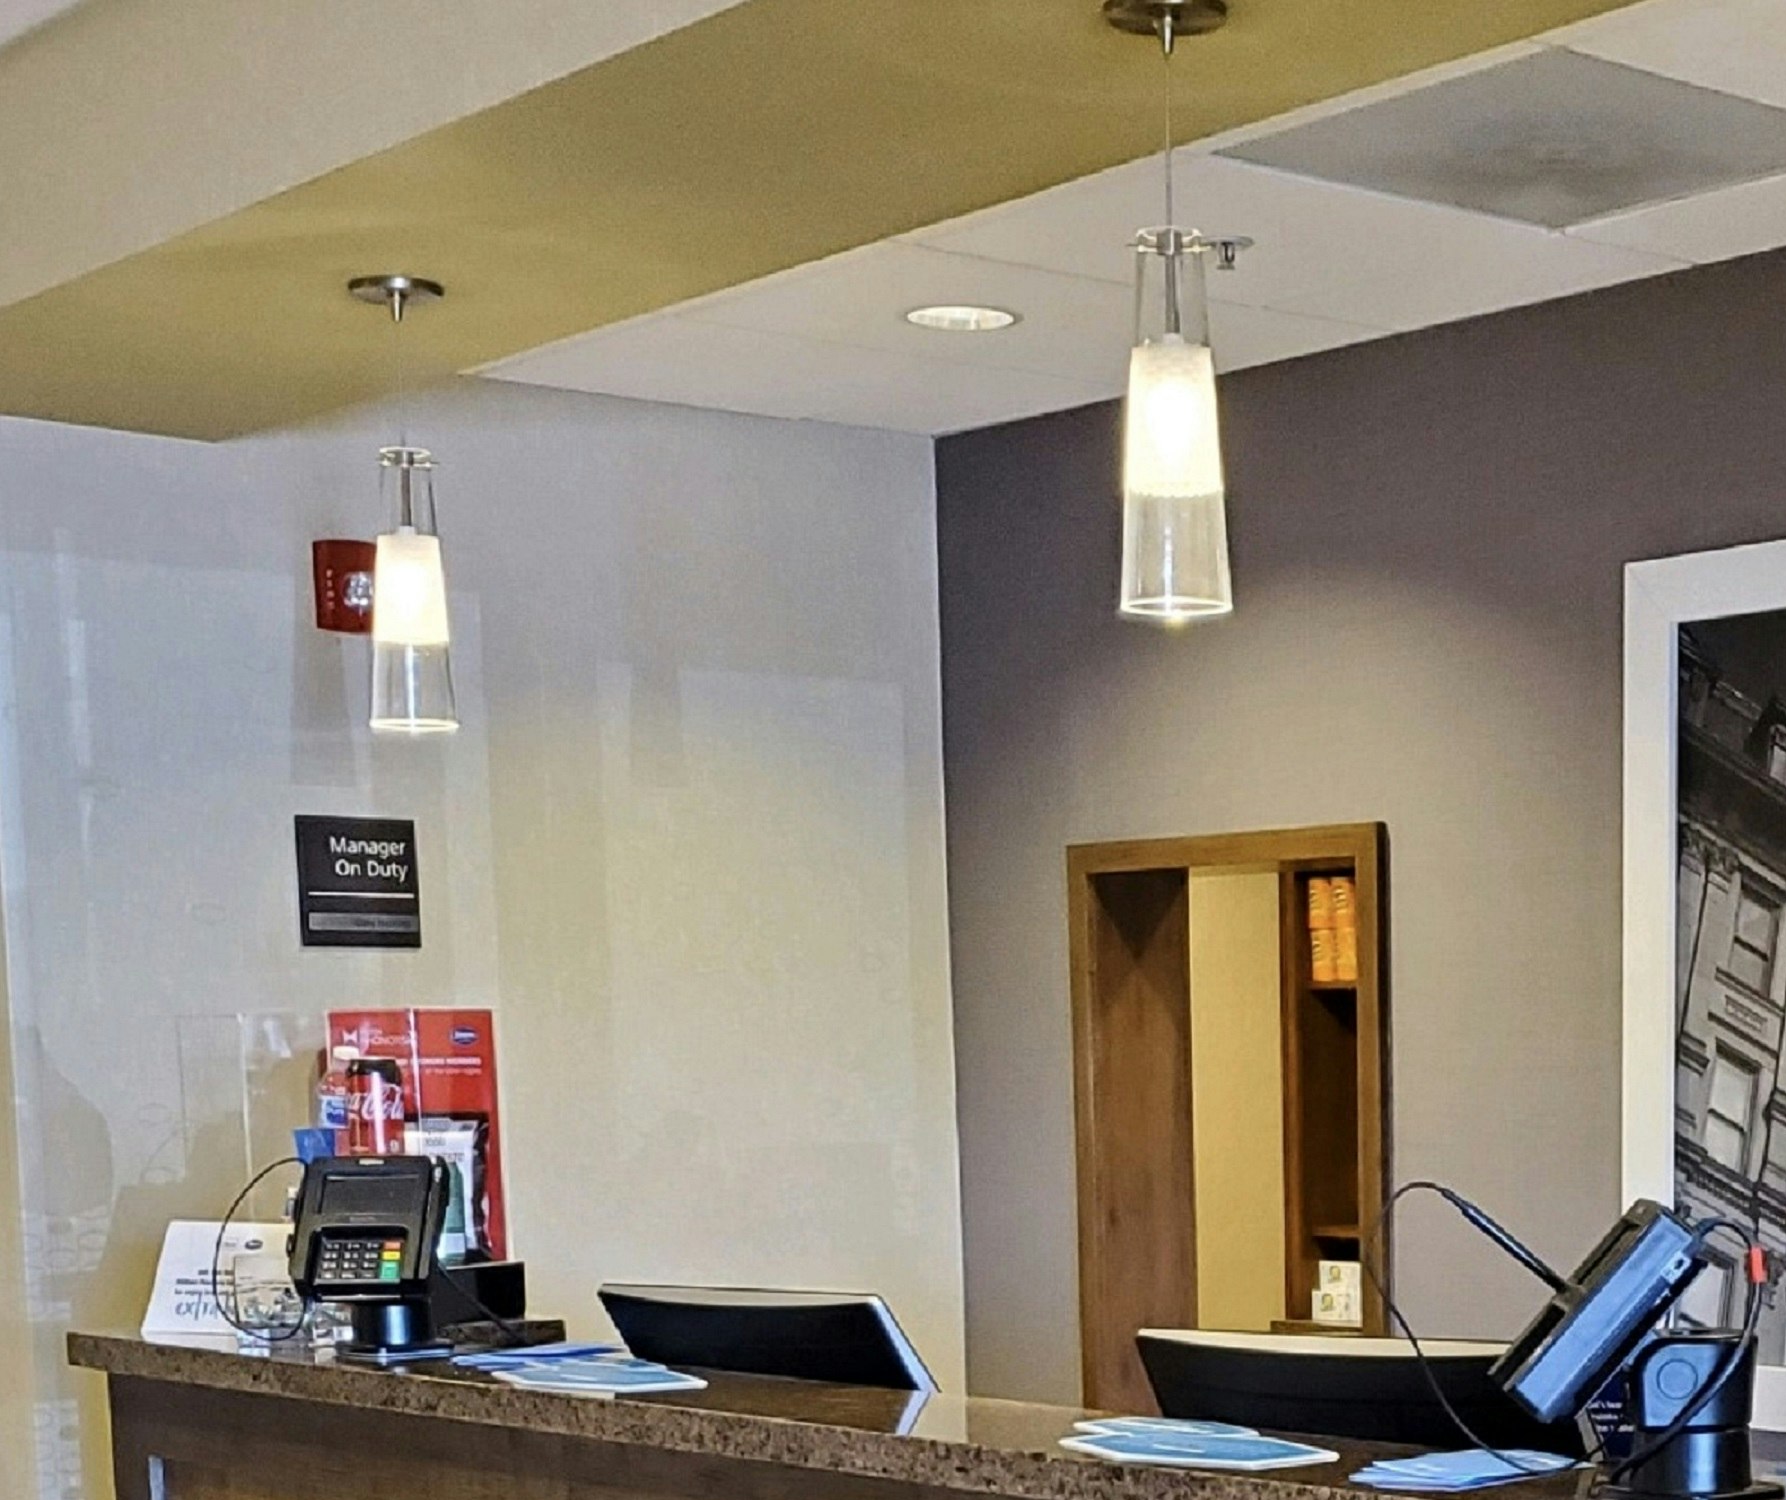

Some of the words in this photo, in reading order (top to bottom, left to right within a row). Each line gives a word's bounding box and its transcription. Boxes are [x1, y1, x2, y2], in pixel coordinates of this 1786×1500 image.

[329, 835, 406, 860] Manager
[334, 858, 361, 877] On
[367, 860, 409, 883] Duty
